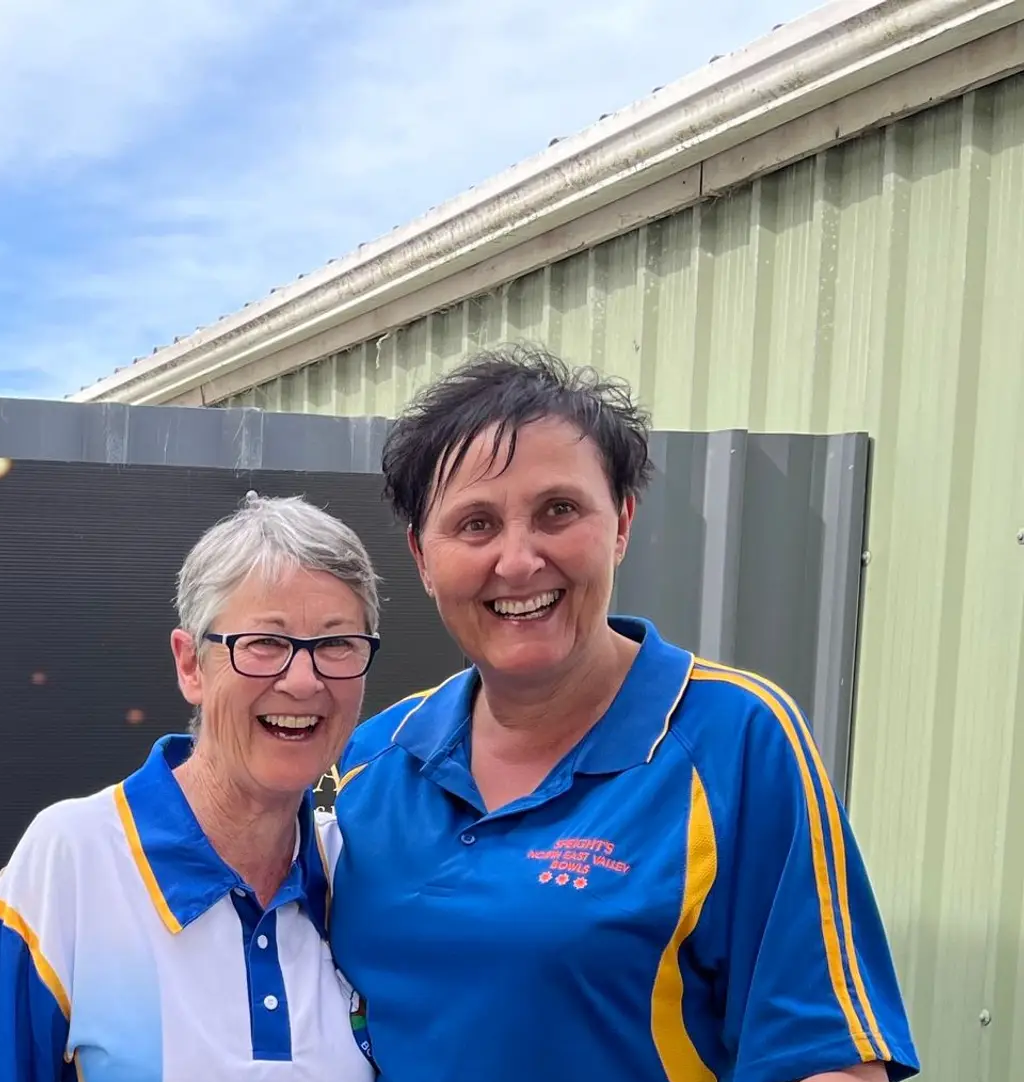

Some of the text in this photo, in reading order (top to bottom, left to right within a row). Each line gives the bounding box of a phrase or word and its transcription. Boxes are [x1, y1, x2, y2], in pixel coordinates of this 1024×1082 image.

[550, 860, 591, 874] BOWLS
[563, 851, 590, 862] EAST
[593, 854, 631, 873] VALLEY
